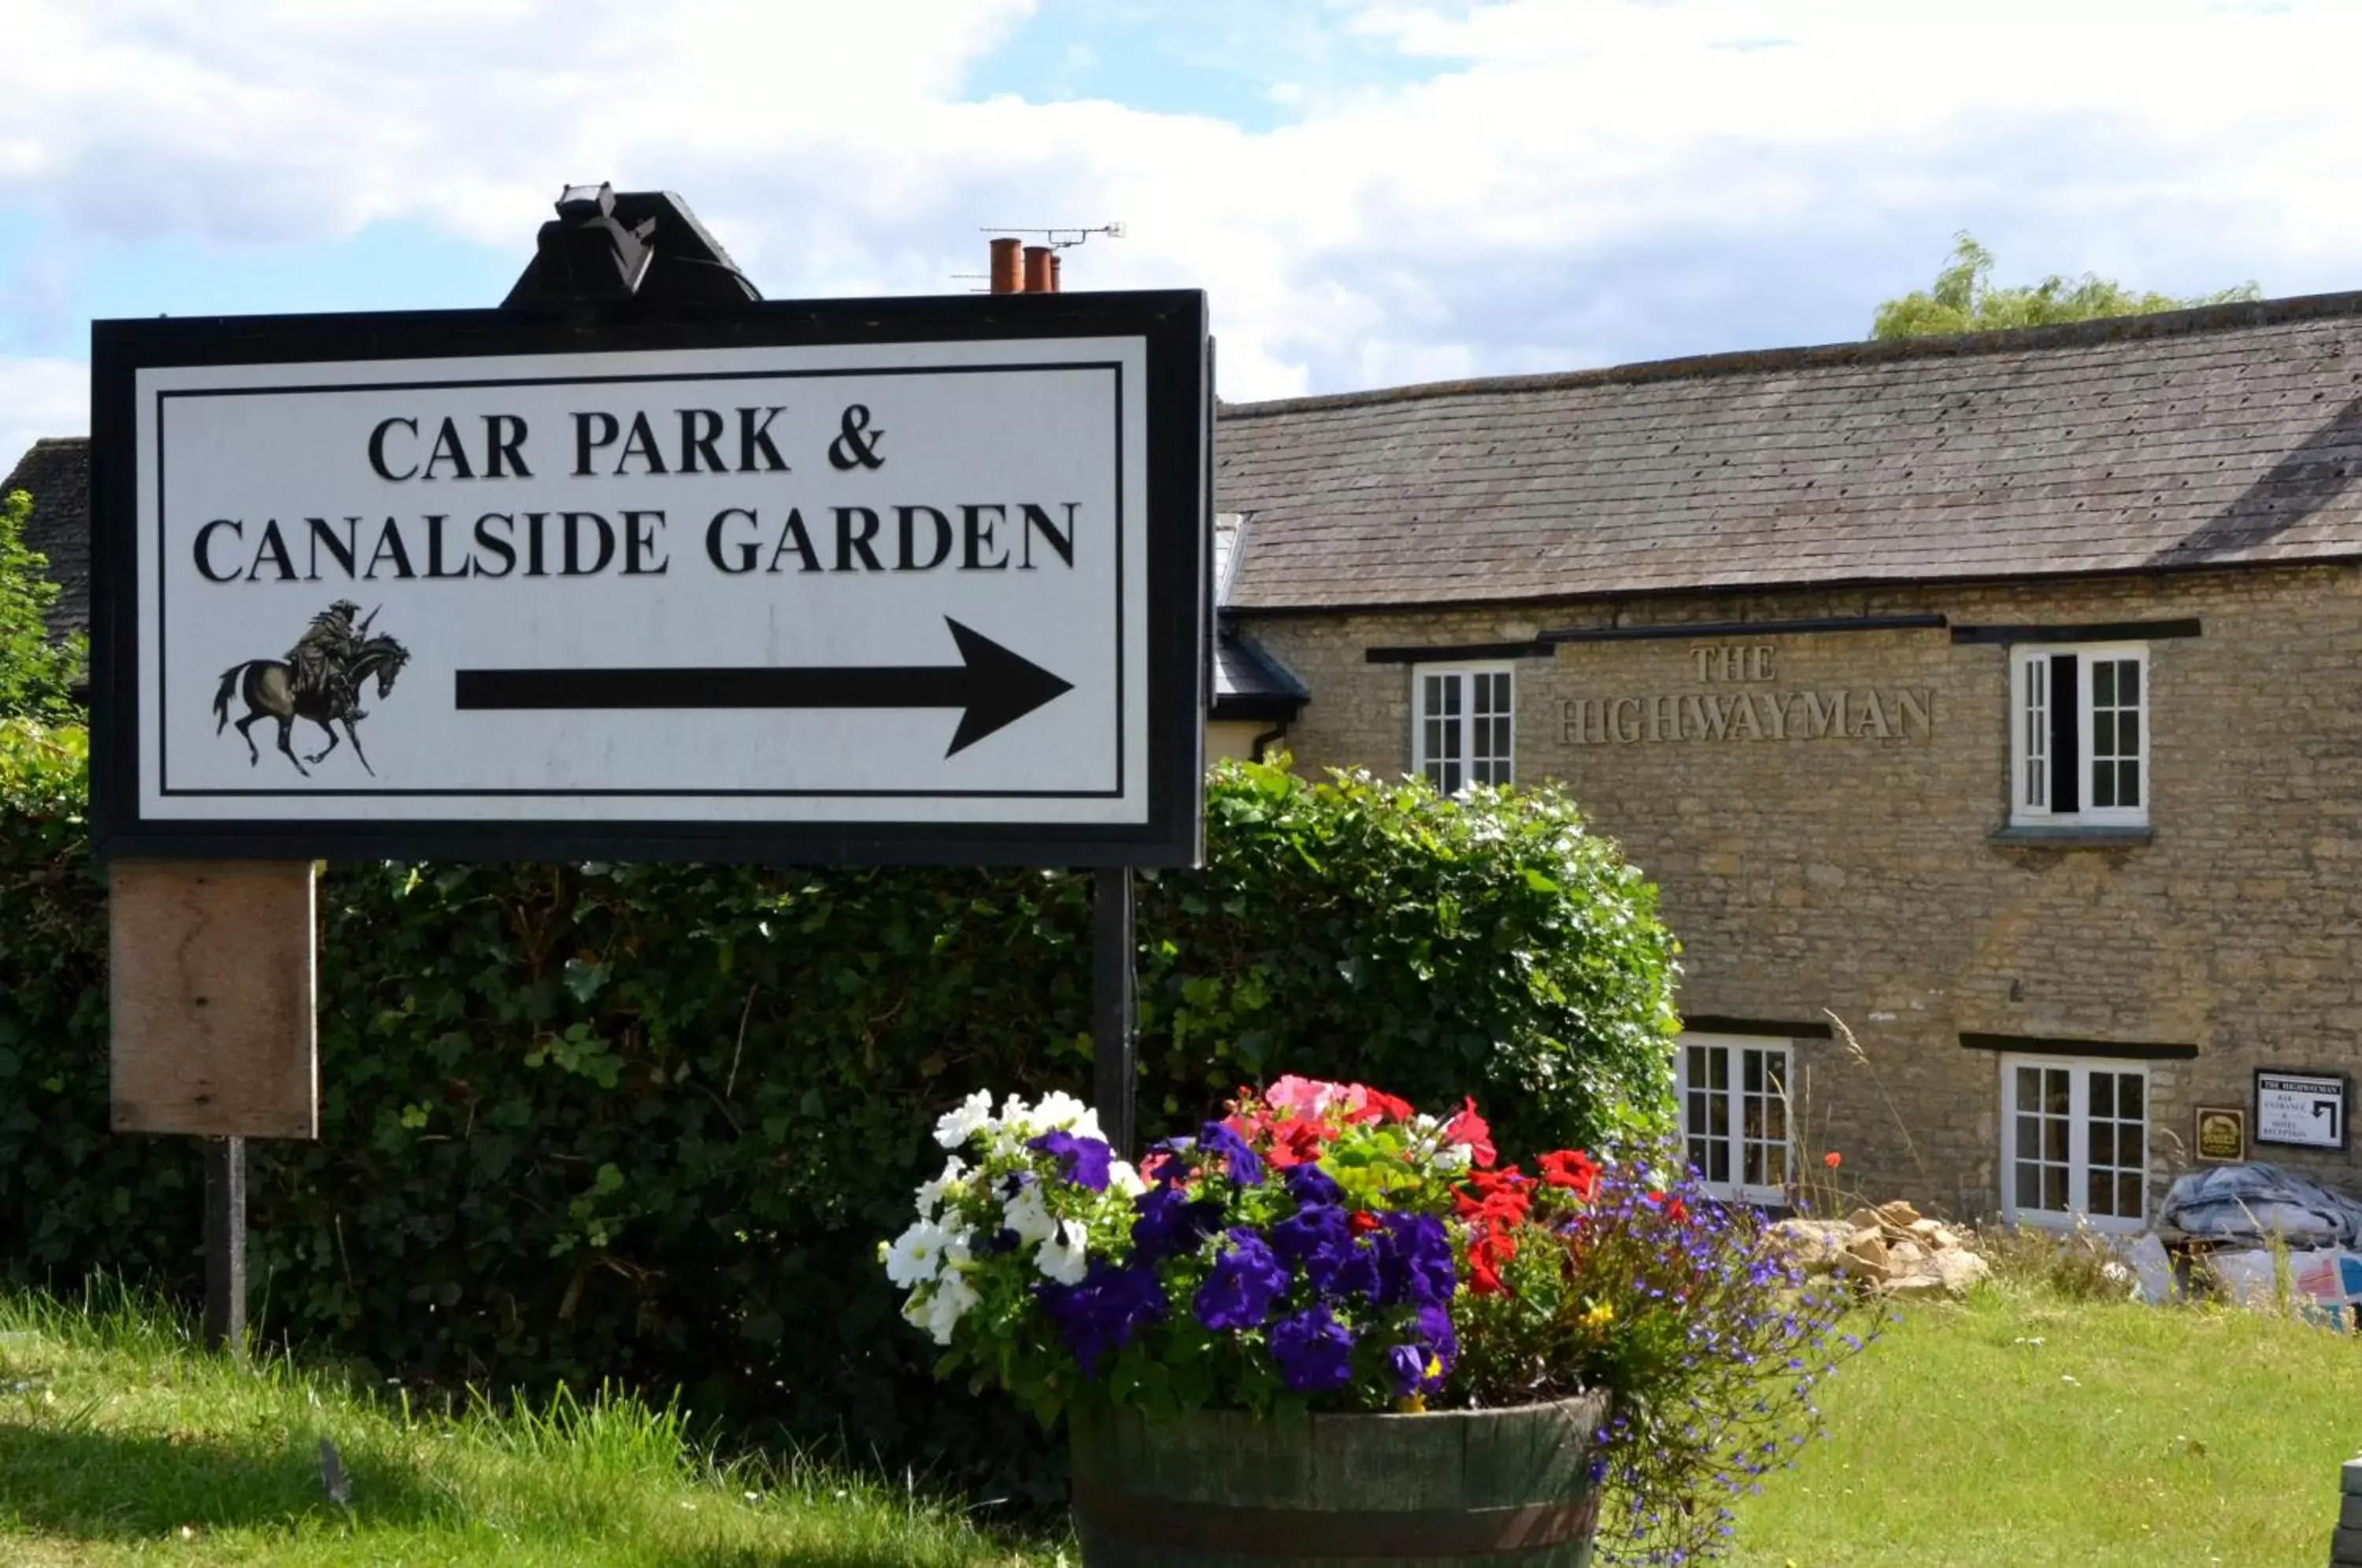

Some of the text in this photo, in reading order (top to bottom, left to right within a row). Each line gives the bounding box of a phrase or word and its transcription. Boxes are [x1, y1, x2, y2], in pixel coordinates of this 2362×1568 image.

[368, 404, 887, 483] CAR PARK &
[193, 502, 1081, 583] CANALSIDE GARDEN
[1690, 645, 1777, 684] THE
[1557, 686, 1935, 745] HIGHWAYMAN
